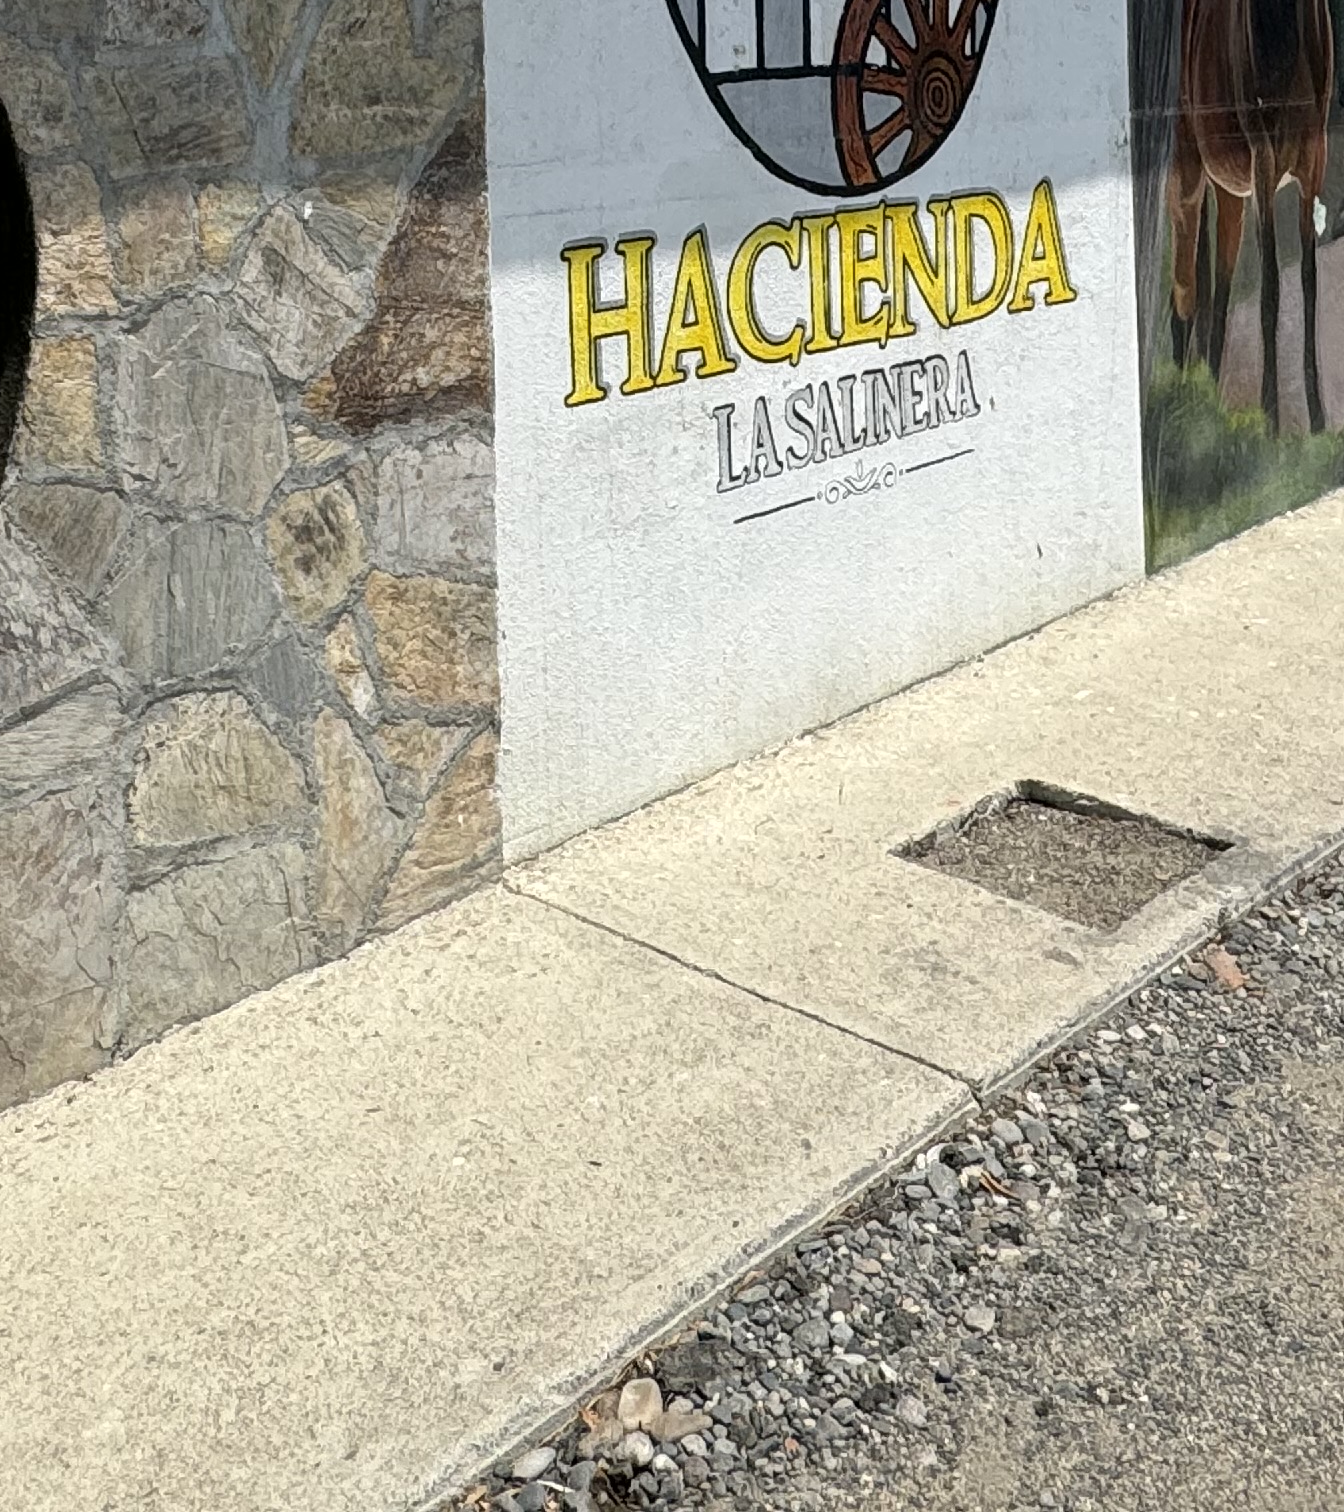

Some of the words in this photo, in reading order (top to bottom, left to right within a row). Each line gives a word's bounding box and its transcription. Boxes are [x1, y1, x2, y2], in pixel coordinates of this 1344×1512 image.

[560, 177, 1077, 408] HACIENDA
[711, 396, 784, 494] LA
[784, 351, 981, 472] SALINERA
